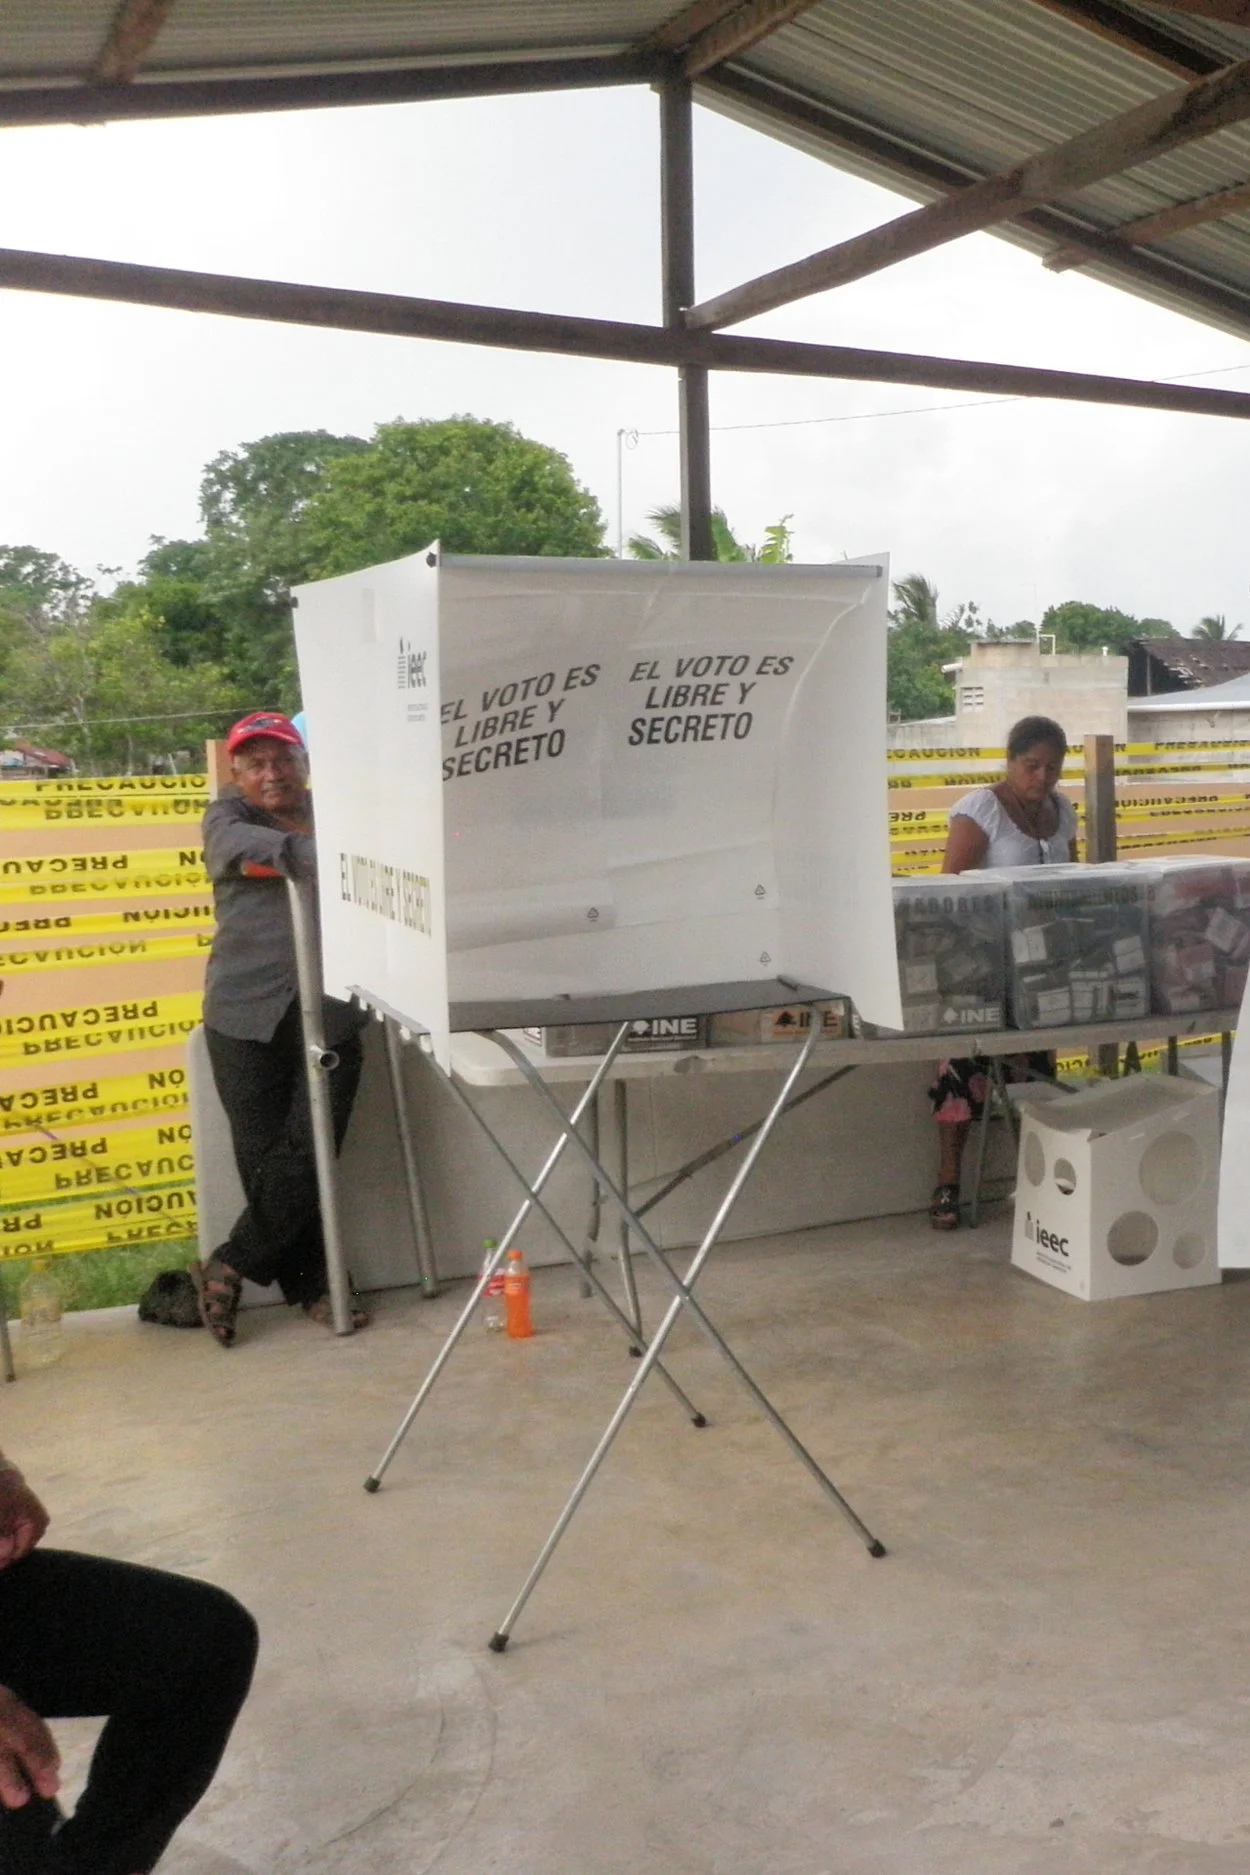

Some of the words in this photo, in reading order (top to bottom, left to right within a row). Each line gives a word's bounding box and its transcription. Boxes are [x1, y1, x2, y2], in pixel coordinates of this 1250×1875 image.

[629, 661, 661, 682] EL
[675, 655, 750, 678] VOTO
[756, 656, 794, 675] ES
[440, 700, 467, 725] EL
[481, 672, 555, 712] VOTO
[563, 664, 600, 691] ES
[645, 683, 730, 709] LIBRE
[739, 682, 757, 704] Y
[454, 705, 537, 748] LIBRE
[548, 698, 566, 723] Y
[628, 712, 753, 746] SECRETO
[443, 729, 565, 781] SECRETO
[652, 1018, 697, 1035] INE
[1036, 1219, 1069, 1257] ieec
